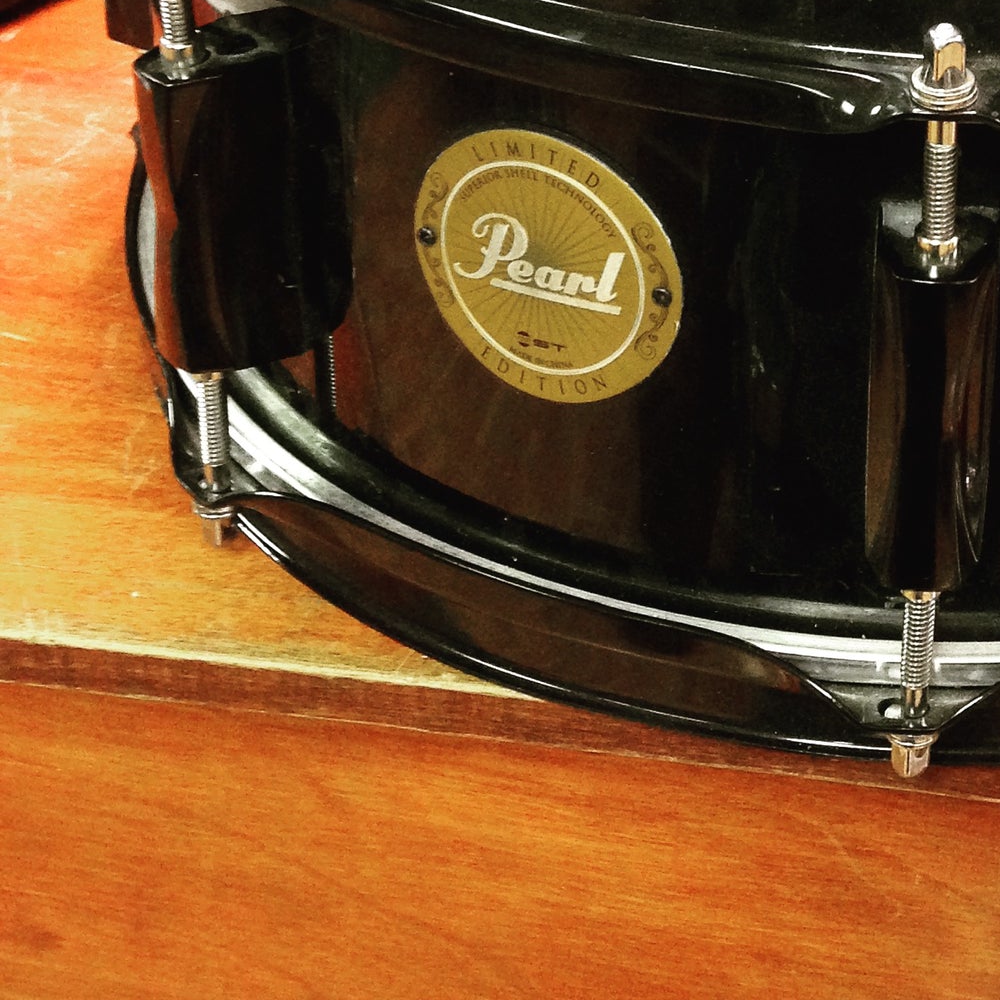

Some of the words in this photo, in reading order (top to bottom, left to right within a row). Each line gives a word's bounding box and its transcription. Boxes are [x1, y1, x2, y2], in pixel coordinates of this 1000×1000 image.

[472, 140, 602, 189] LIMITED
[460, 170, 503, 202] SUPERIOR
[505, 168, 539, 182] SHELL
[544, 175, 617, 239] TECHNOLOGY
[453, 211, 626, 303] Pearl
[481, 344, 609, 395] EDITION
